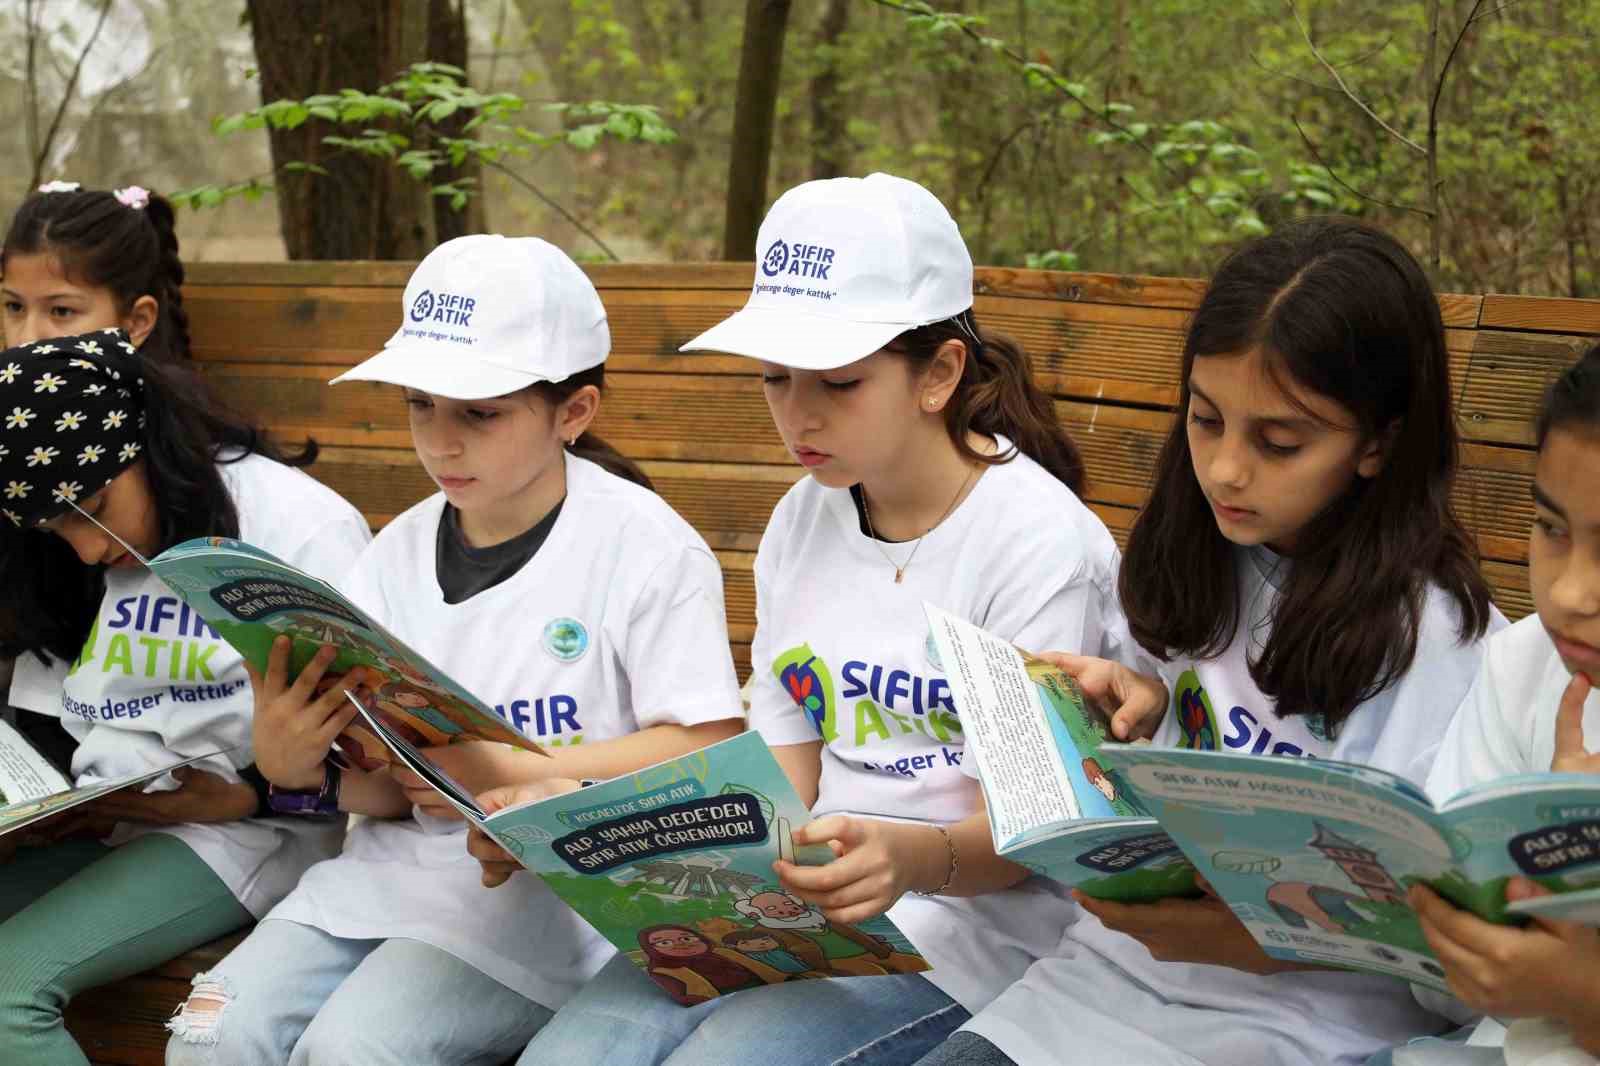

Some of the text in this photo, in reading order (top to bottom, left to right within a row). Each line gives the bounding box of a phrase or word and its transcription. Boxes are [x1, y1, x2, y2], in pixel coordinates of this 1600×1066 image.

[792, 243, 835, 264] SIFIR
[788, 260, 831, 280] ATIK
[437, 293, 476, 312] SIFIR
[433, 308, 472, 327] ATIK
[102, 633, 223, 682] ATIK
[841, 661, 958, 715] SIFIR
[101, 690, 164, 720] deger
[639, 792, 670, 809] SIFIR
[670, 783, 697, 800] ATIK
[598, 819, 658, 842] YAHYA
[658, 802, 749, 829] DEDE'DEN
[578, 848, 620, 869] SIFIR
[618, 838, 656, 856] ATIK
